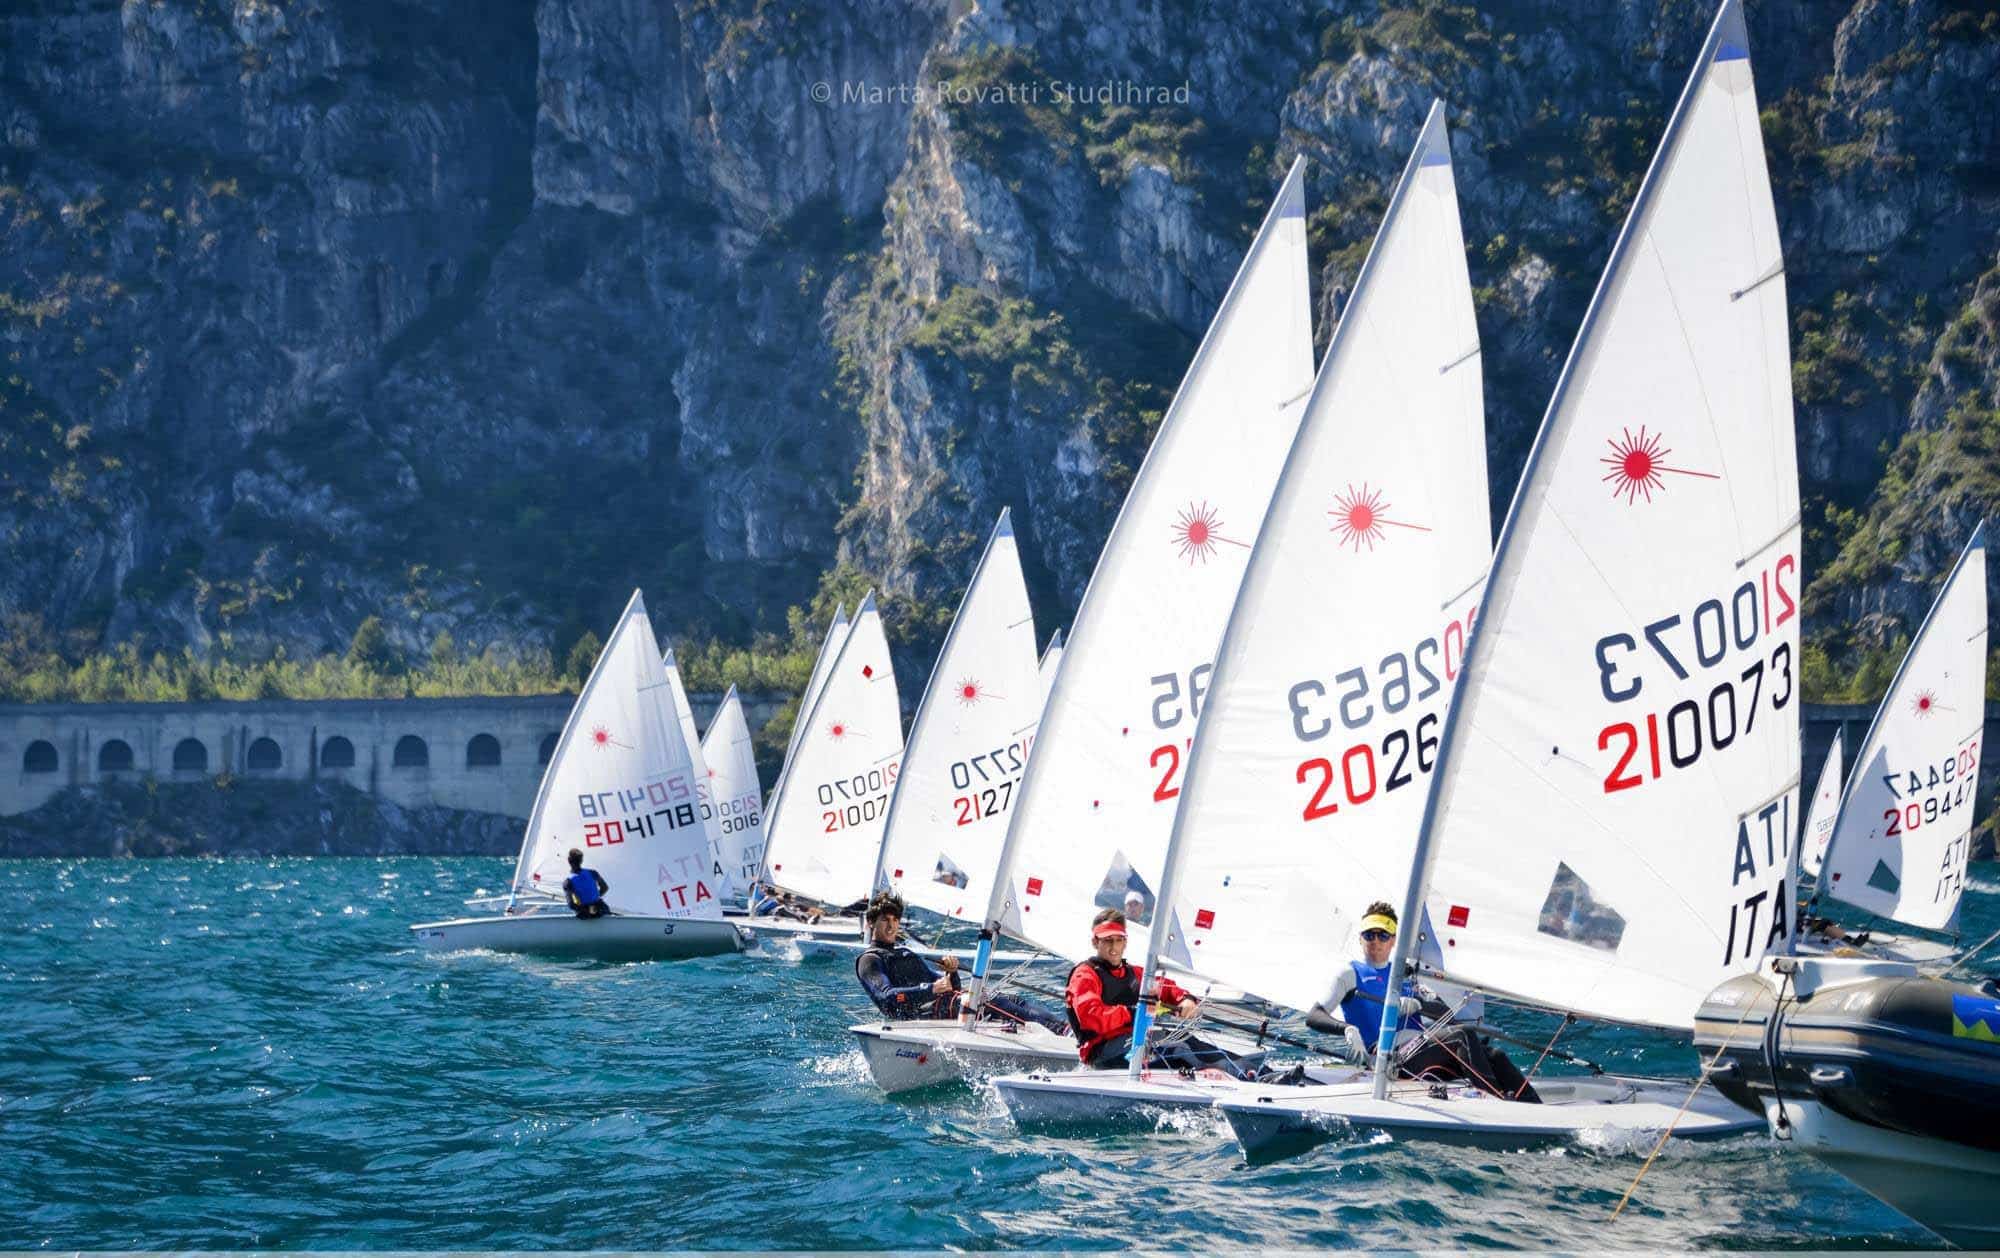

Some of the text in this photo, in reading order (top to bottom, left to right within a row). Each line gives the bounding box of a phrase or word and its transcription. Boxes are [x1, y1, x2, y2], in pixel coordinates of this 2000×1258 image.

[1597, 641, 1792, 794] 210073
[1296, 703, 1448, 822] 2026
[583, 802, 696, 848] 204178
[822, 793, 888, 834] 21007
[953, 776, 1021, 827] 2127
[1884, 774, 1974, 838] 209447
[661, 879, 713, 910] ITA
[742, 863, 761, 879] IT
[1934, 869, 1962, 905] ITA
[1723, 878, 1788, 967] ITA
